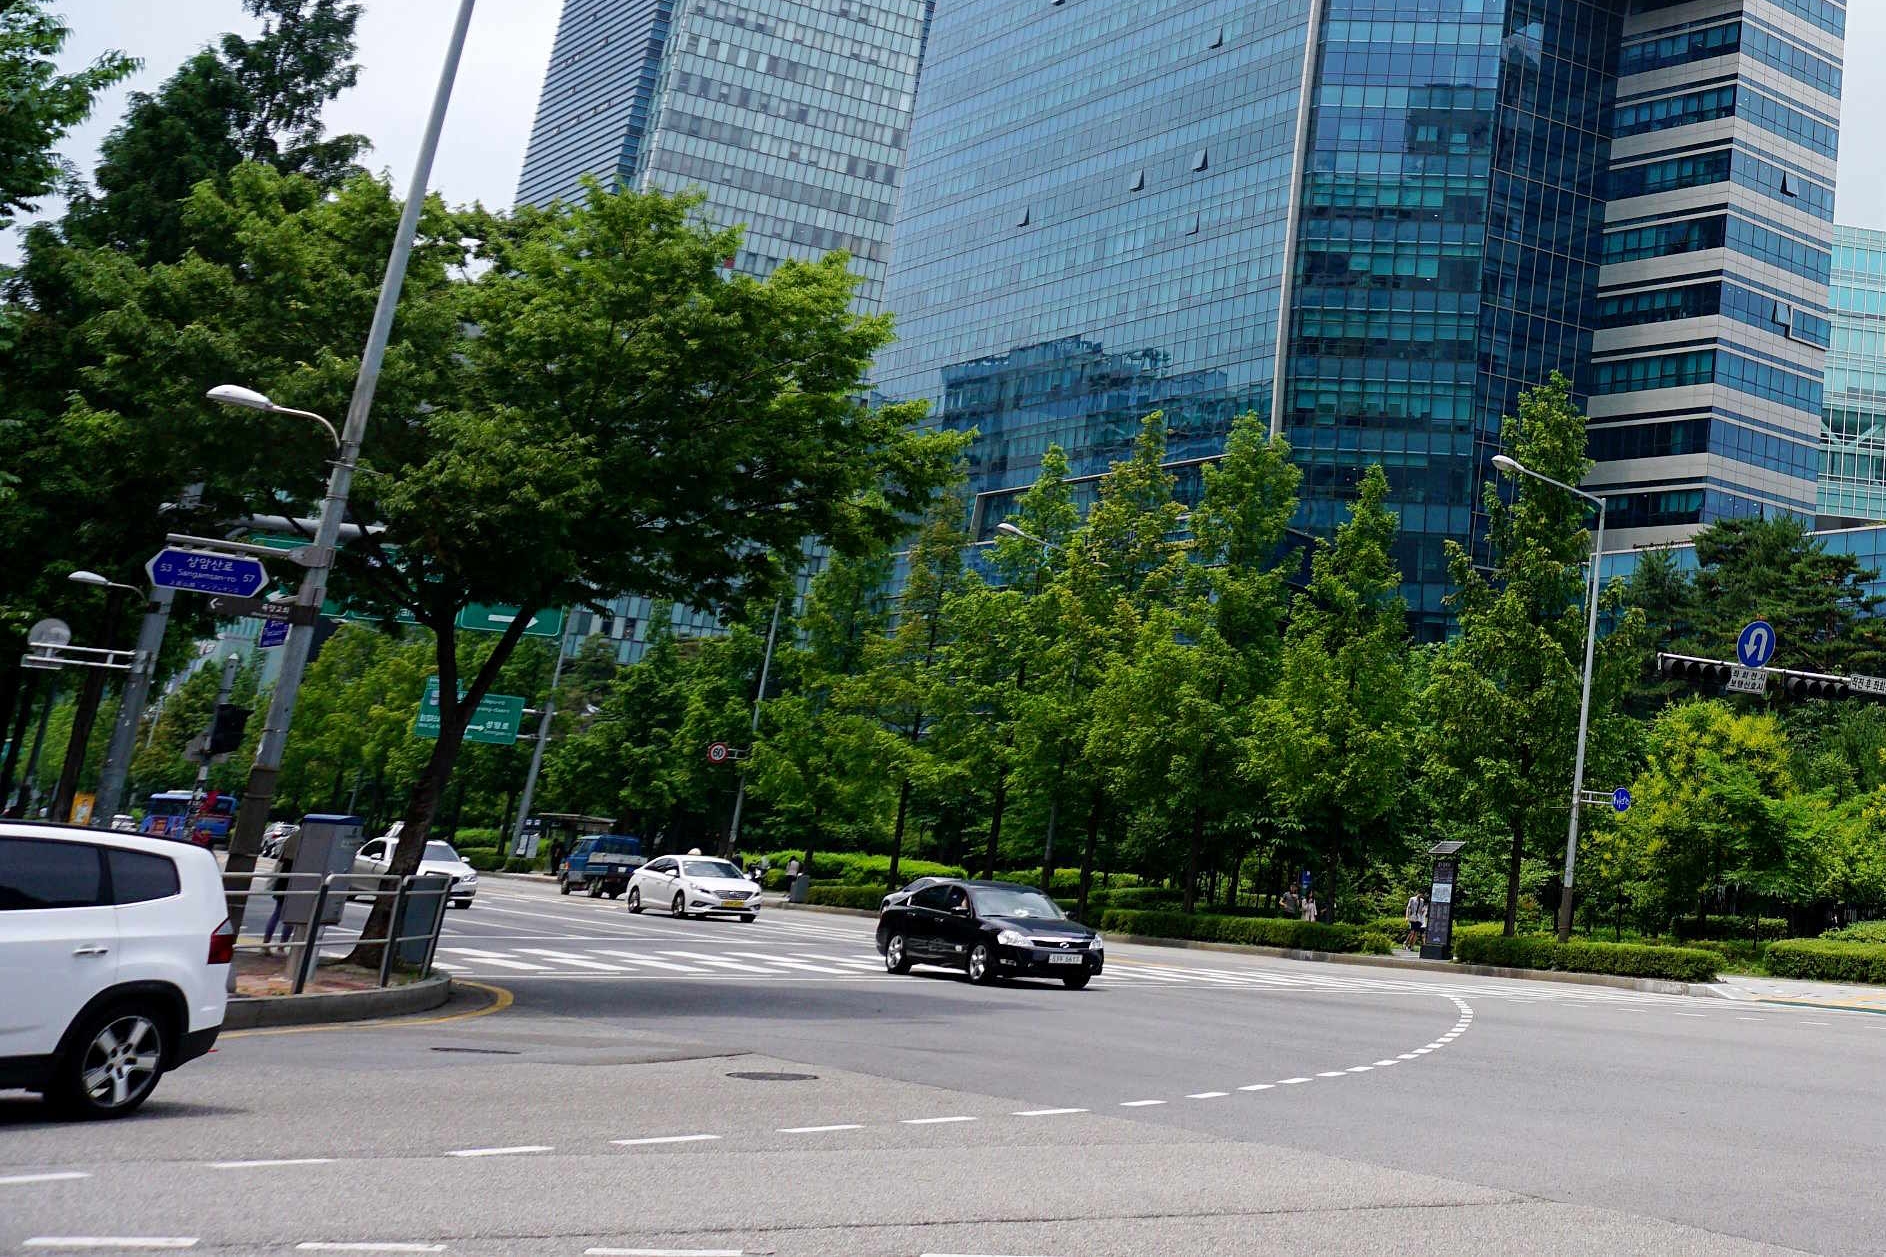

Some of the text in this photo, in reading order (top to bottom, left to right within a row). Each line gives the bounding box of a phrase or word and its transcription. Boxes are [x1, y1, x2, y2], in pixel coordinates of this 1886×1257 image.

[160, 563, 172, 572] 53
[186, 556, 234, 572] 상암산로
[177, 568, 237, 583] Sangamsan-ro
[243, 574, 255, 583] 57
